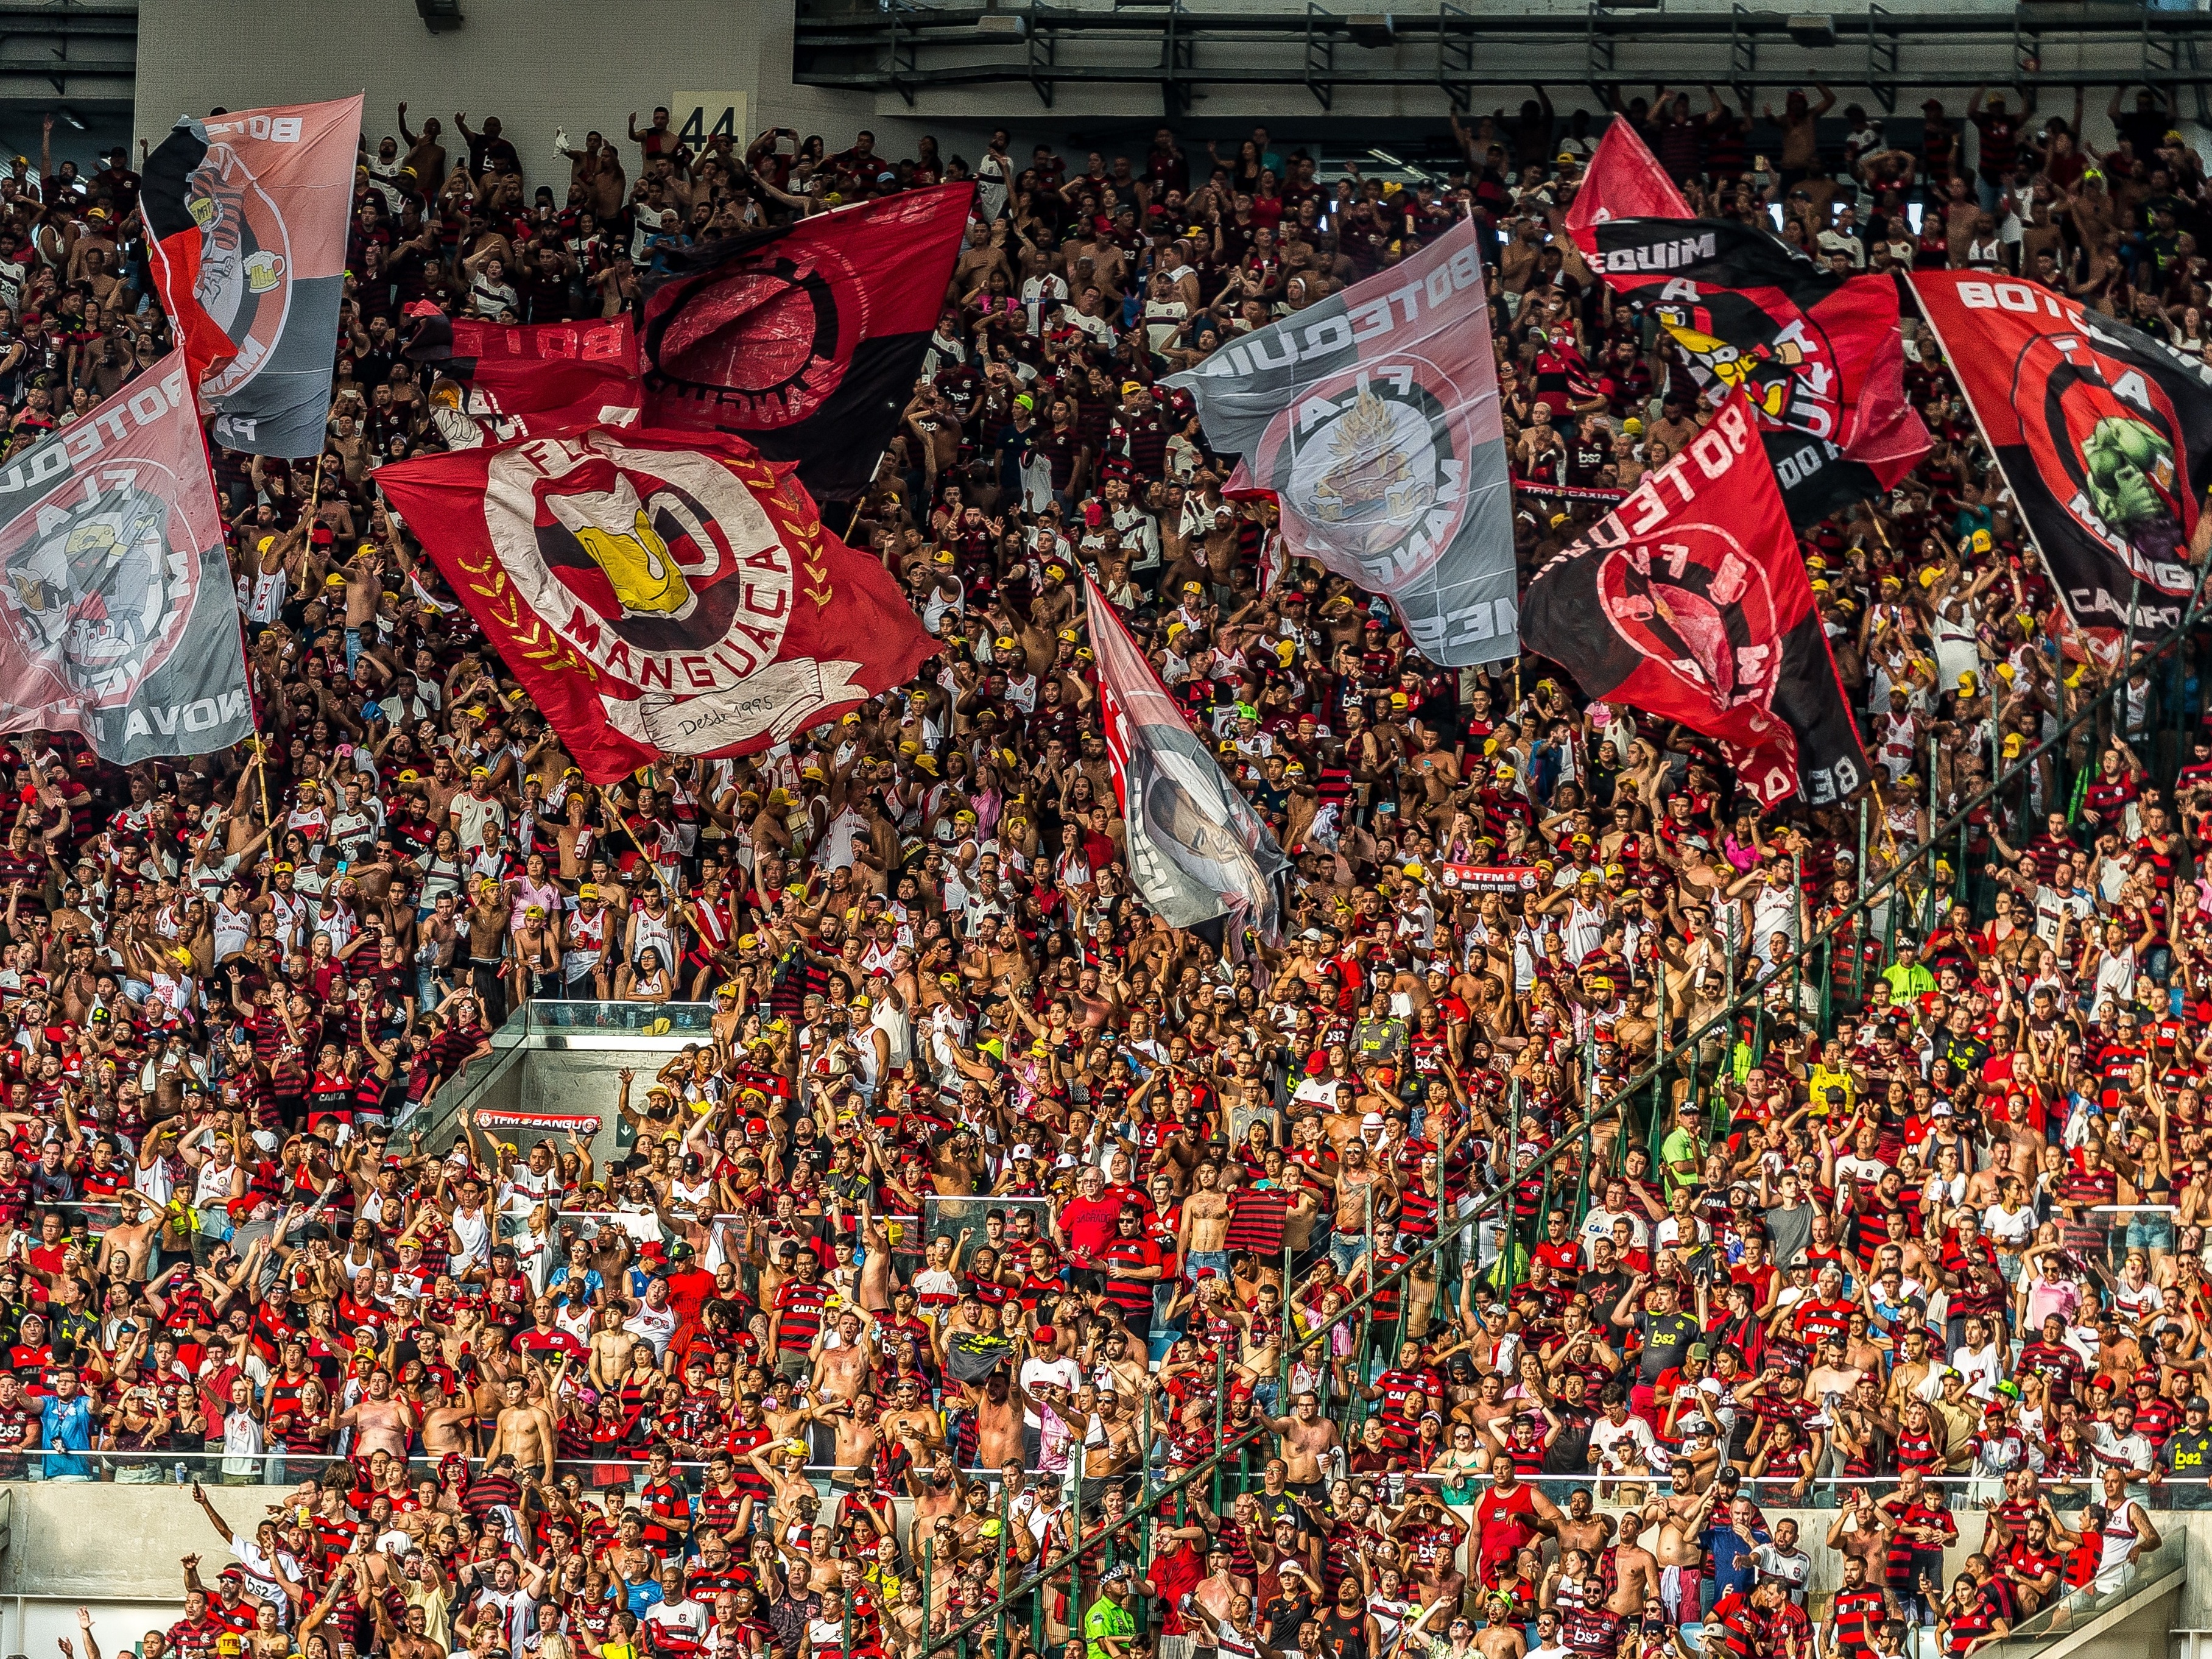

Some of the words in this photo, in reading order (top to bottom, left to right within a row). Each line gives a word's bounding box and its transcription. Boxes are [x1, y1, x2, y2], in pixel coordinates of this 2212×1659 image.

[678, 107, 739, 150] 44
[1579, 451, 1599, 463] bs2
[1526, 486, 1553, 495] TFM
[1342, 694, 1362, 707] bs2
[678, 709, 729, 736] Desde
[733, 695, 775, 719] 1995
[1473, 873, 1504, 881] TFM
[1362, 1037, 1381, 1051] bs2
[1415, 1055, 1438, 1069] bs2
[493, 1115, 520, 1125] TFM
[532, 1119, 582, 1131] BANGU
[792, 1304, 823, 1314] CAIXA
[1652, 1330, 1676, 1344] bs2
[2175, 1449, 2202, 1464] bs2
[248, 1577, 269, 1597] bs2
[1839, 1604, 1847, 1615] 10
[1574, 1627, 1600, 1643] bs2
